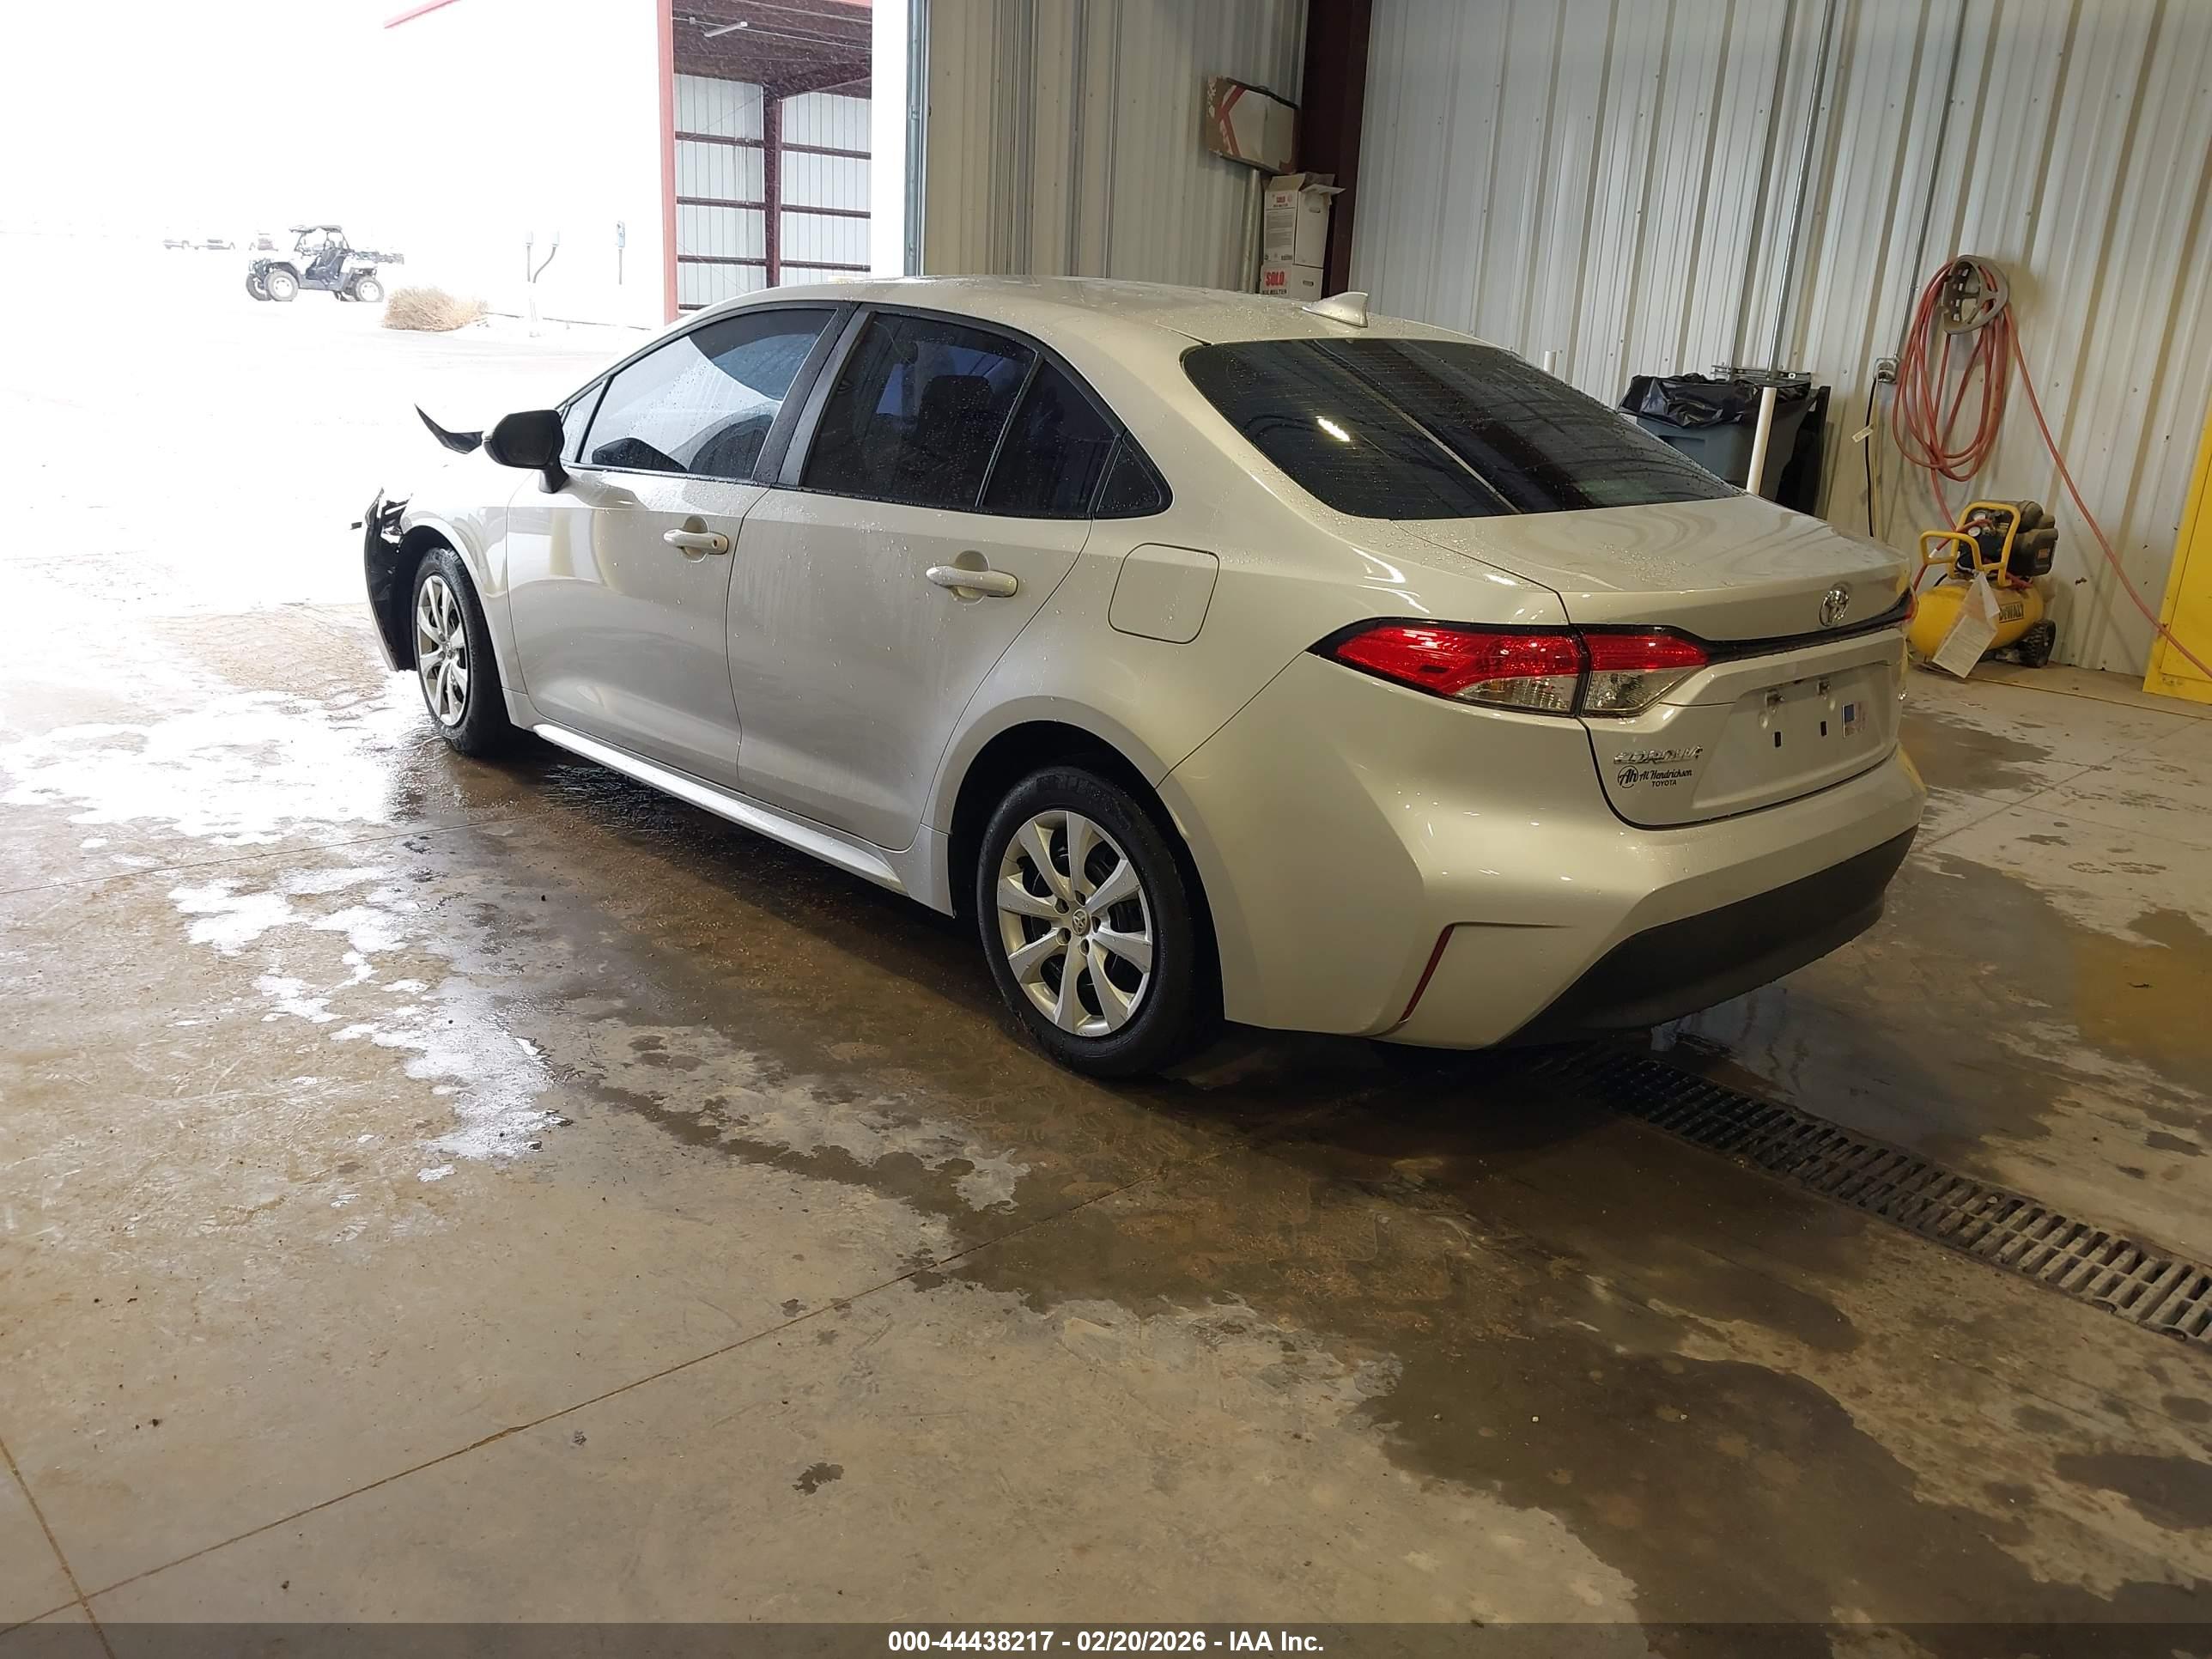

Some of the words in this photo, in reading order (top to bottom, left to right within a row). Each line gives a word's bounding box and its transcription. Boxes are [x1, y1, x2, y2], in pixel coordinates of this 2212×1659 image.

[1266, 270, 1285, 287] SOLO
[1639, 770, 1650, 781] Al
[1650, 769, 1692, 781] Hendrickson
[1652, 779, 1677, 787] TOYOTA
